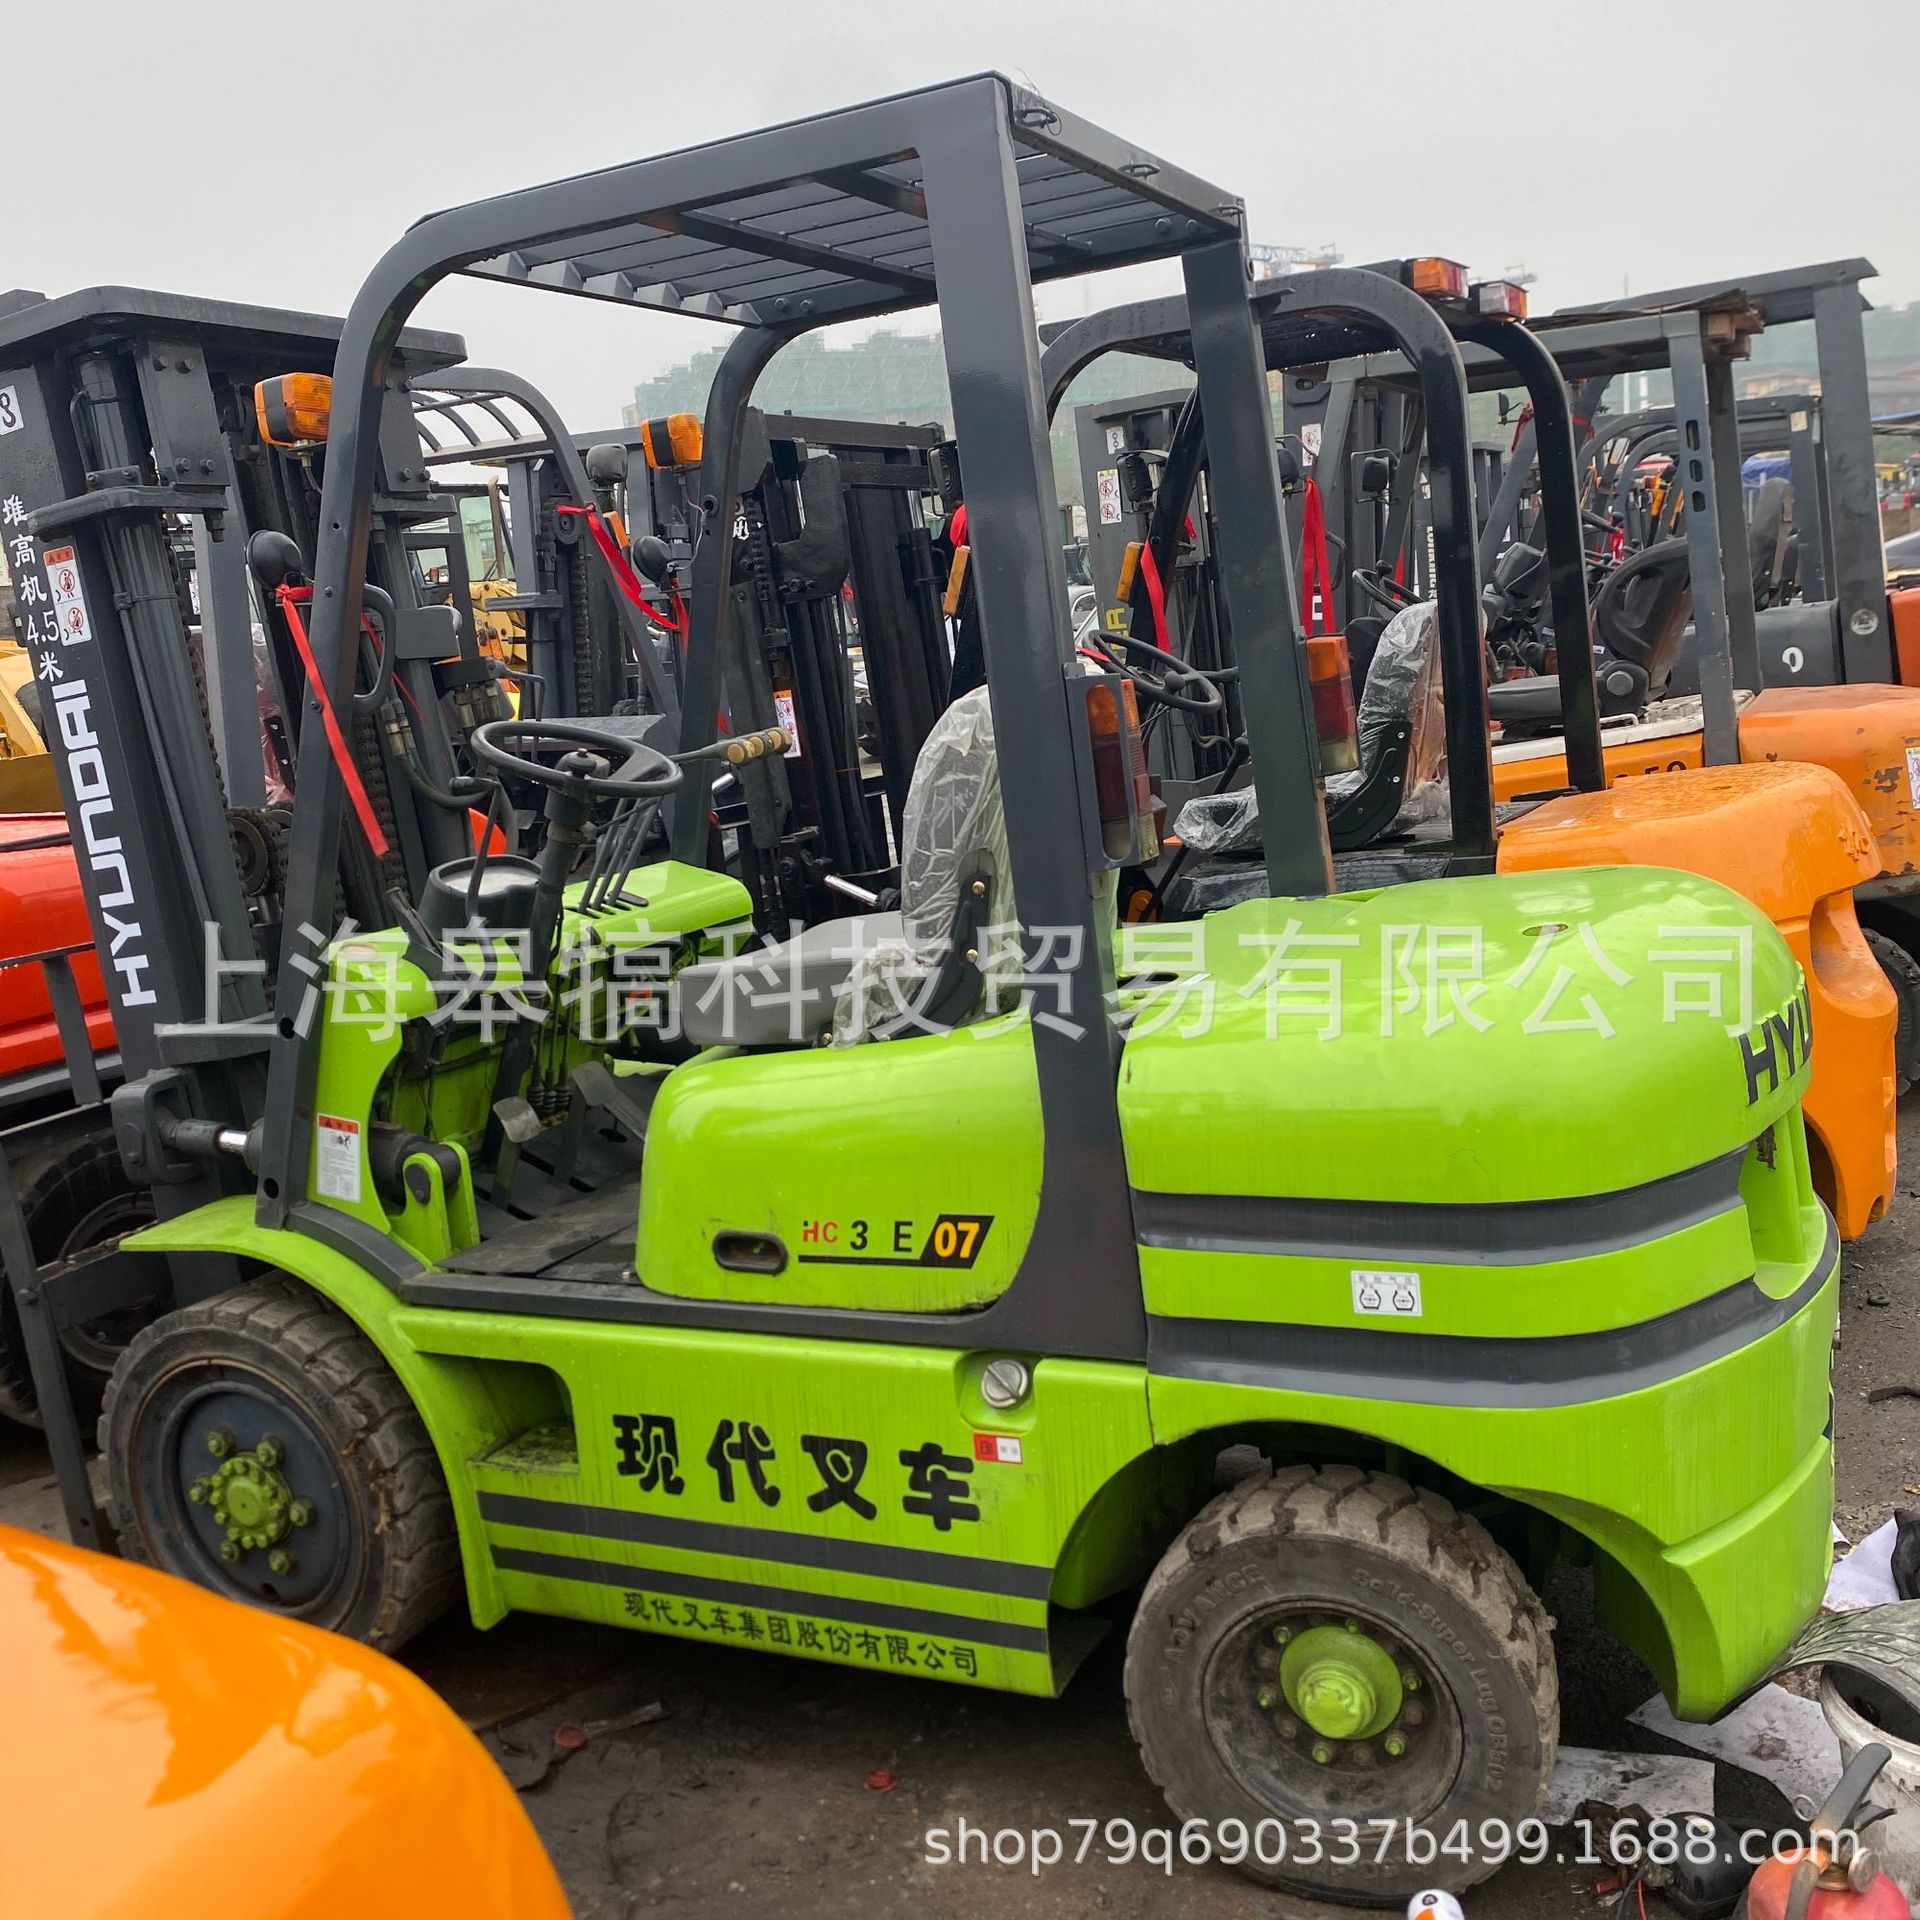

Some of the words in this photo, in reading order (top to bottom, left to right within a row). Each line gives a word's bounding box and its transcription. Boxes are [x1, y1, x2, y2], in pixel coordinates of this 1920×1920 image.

[51, 678, 158, 1007] HYUNDAI
[934, 1221, 980, 1259] 07
[612, 1413, 981, 1531] 现代叉车
[624, 1591, 978, 1678] 现代叉车集团股份有限公司
